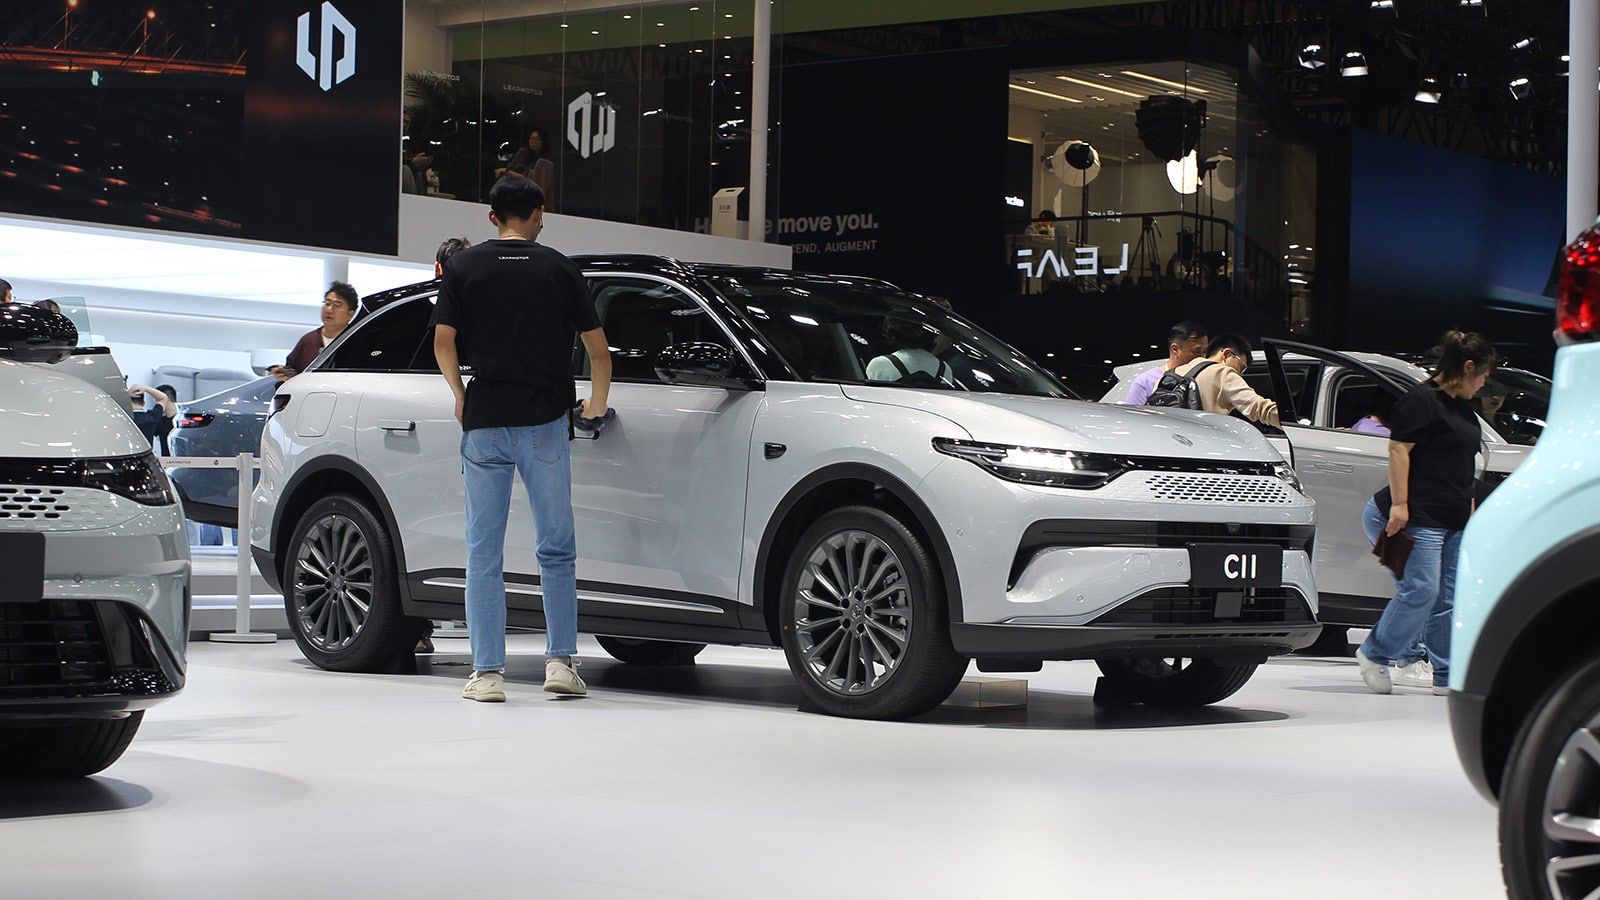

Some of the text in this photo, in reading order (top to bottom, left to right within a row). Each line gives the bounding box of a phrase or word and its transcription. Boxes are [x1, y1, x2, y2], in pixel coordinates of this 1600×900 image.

[777, 215, 832, 234] move
[835, 213, 879, 237] you.
[825, 240, 878, 253] AUGMENT
